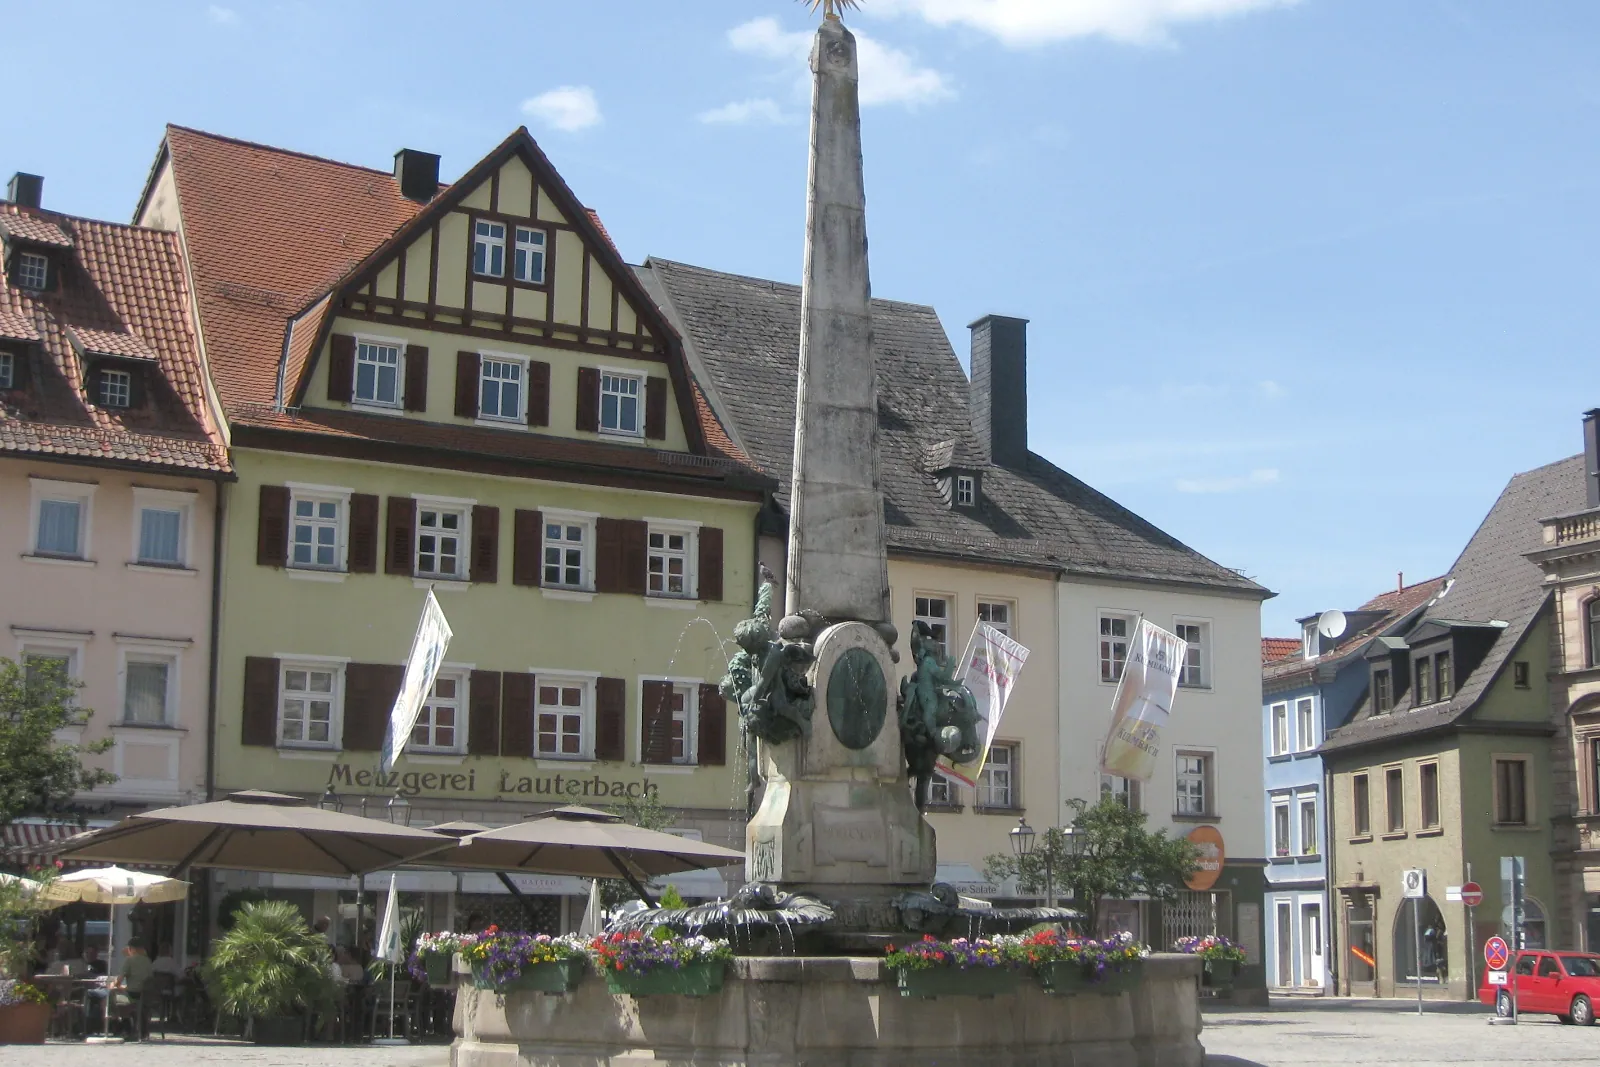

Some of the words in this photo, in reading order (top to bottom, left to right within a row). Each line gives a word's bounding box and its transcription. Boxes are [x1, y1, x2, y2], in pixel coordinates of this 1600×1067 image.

[1135, 652, 1176, 678] KUMBACHER
[328, 764, 475, 795] Metzgerei
[499, 769, 658, 799] Lauterbach
[969, 884, 997, 894] Salate
